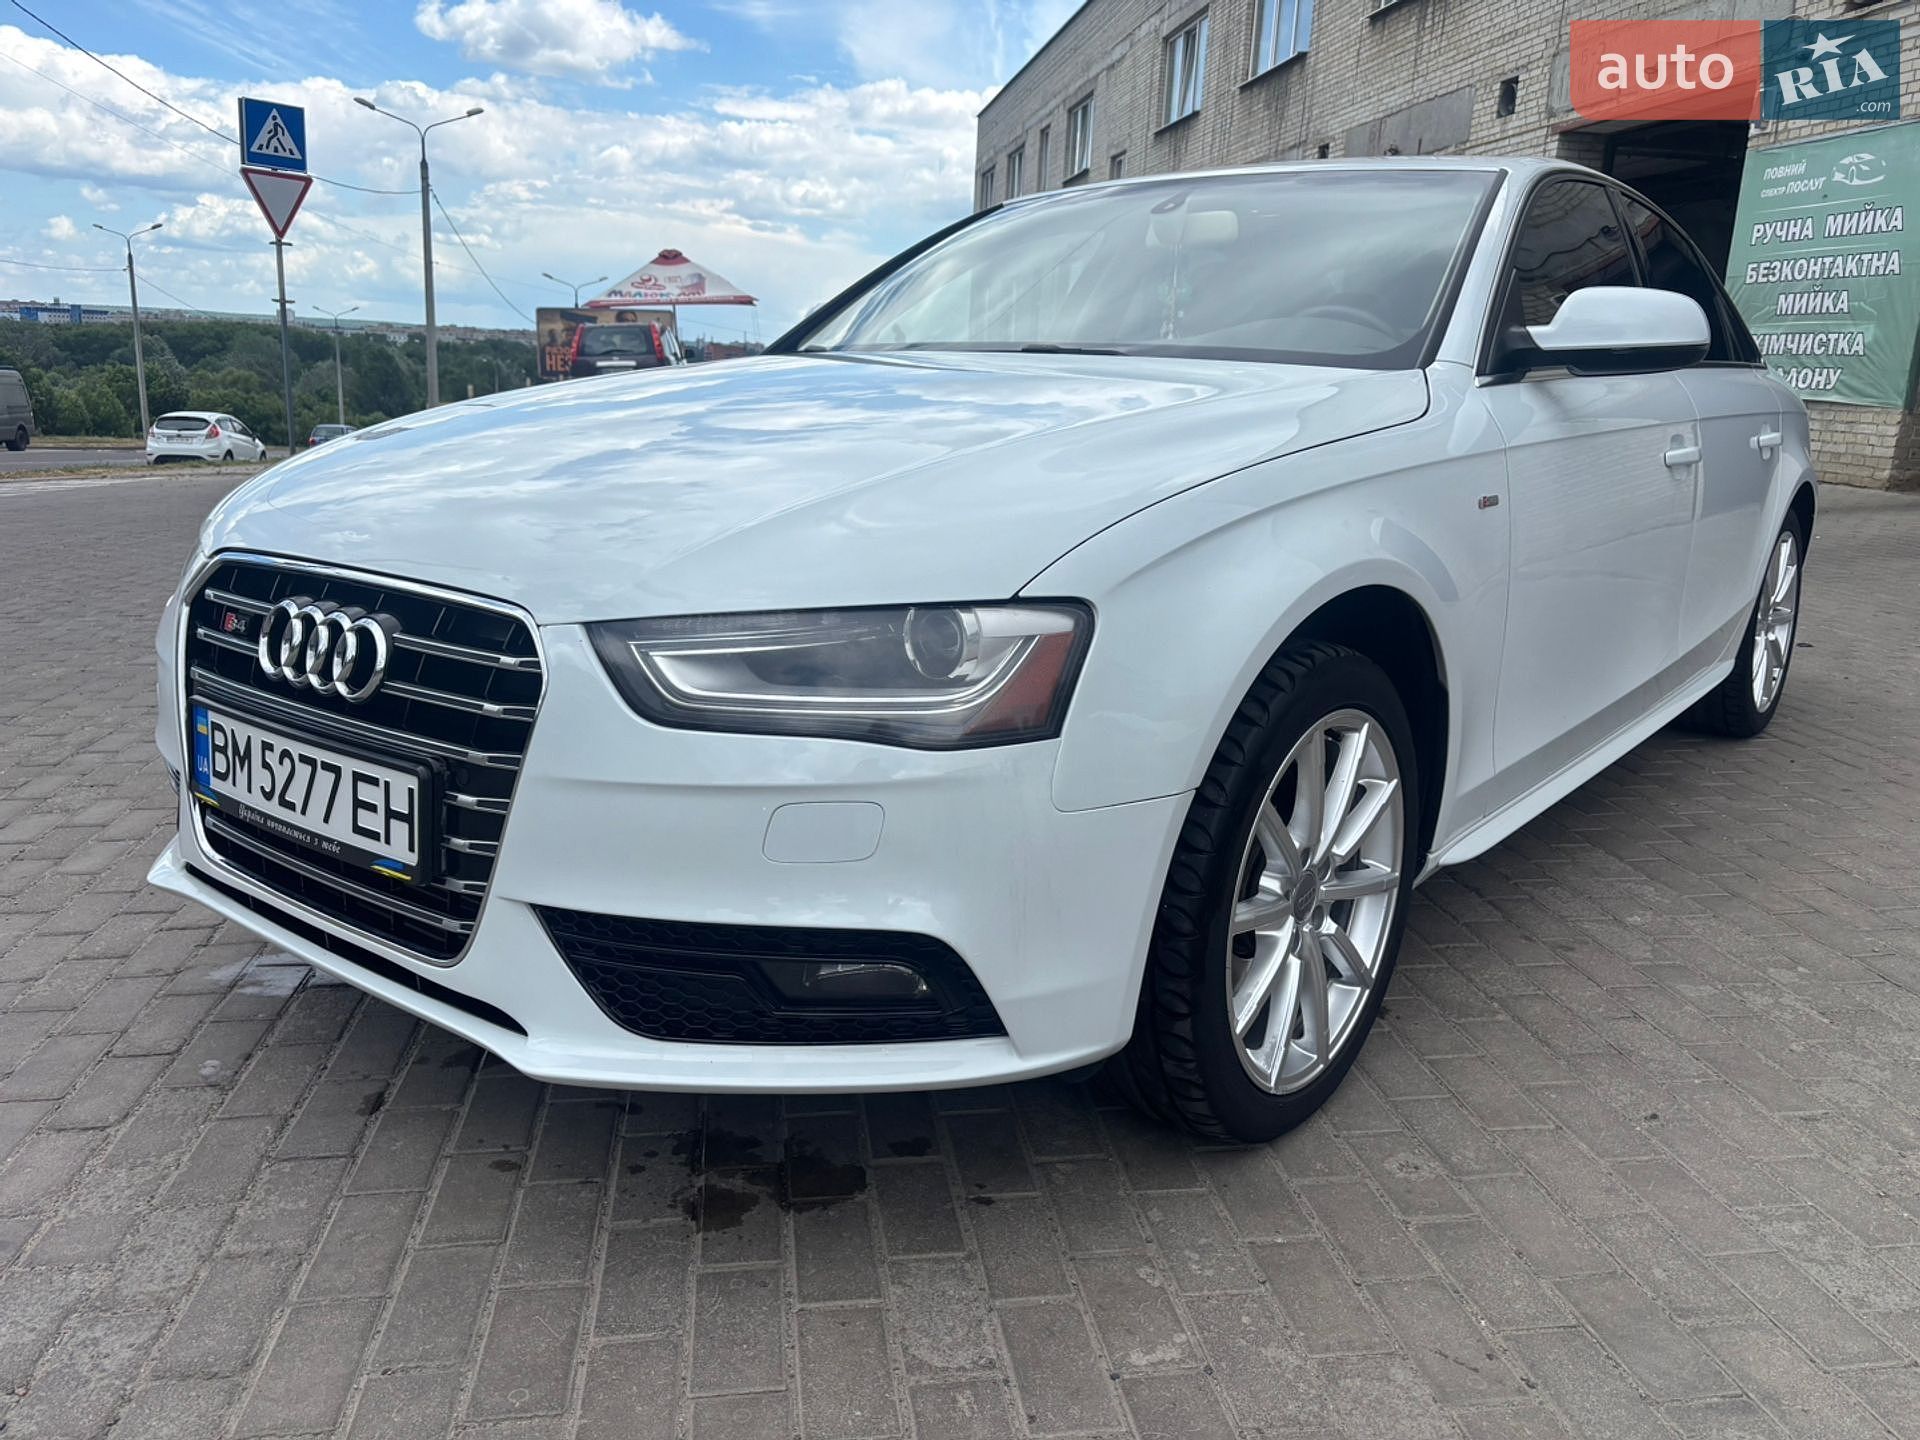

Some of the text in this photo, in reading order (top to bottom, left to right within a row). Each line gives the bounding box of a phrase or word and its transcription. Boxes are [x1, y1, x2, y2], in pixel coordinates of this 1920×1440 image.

[1763, 159, 1807, 180] ПОВНИЙ
[1786, 176, 1827, 194] ПОСЛУГ
[1750, 202, 1904, 246] РУЧНА МИЙКА
[1745, 250, 1901, 284] БЕЗКОНТАКТНА
[1776, 284, 1850, 316] МИЙКА
[1777, 367, 1843, 390] ЛОНУ
[197, 754, 209, 774] UA
[211, 720, 415, 853] BM 5277 EH
